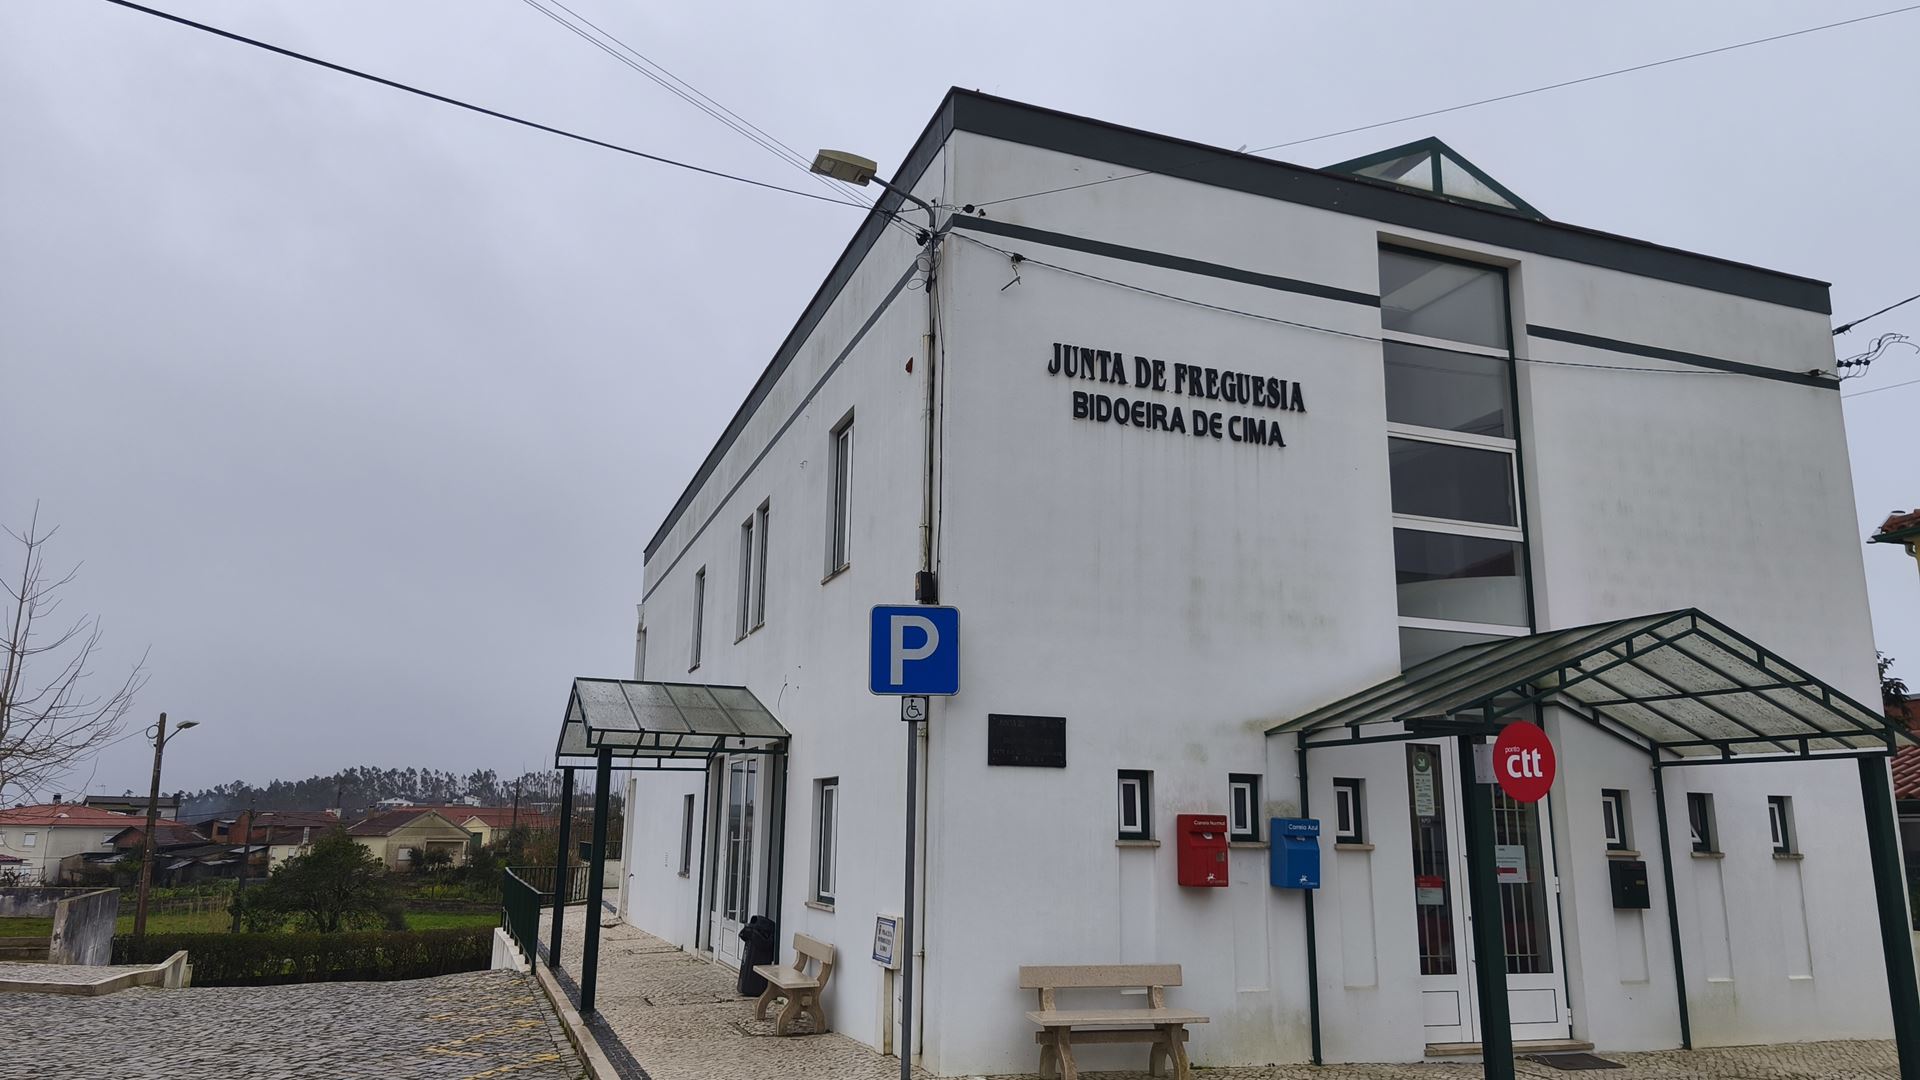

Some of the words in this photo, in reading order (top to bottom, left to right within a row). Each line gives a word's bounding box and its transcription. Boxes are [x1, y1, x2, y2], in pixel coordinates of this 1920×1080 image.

[1048, 342, 1128, 385] JUNTA
[1134, 356, 1167, 392] DE
[1174, 362, 1307, 413] FREGUESIA
[1072, 391, 1186, 434] BIDOEIRA
[1192, 409, 1223, 439] DE
[1228, 415, 1286, 447] CIMA
[890, 615, 939, 685] P
[1506, 748, 1543, 778] ctt
[1288, 823, 1307, 831] Correio
